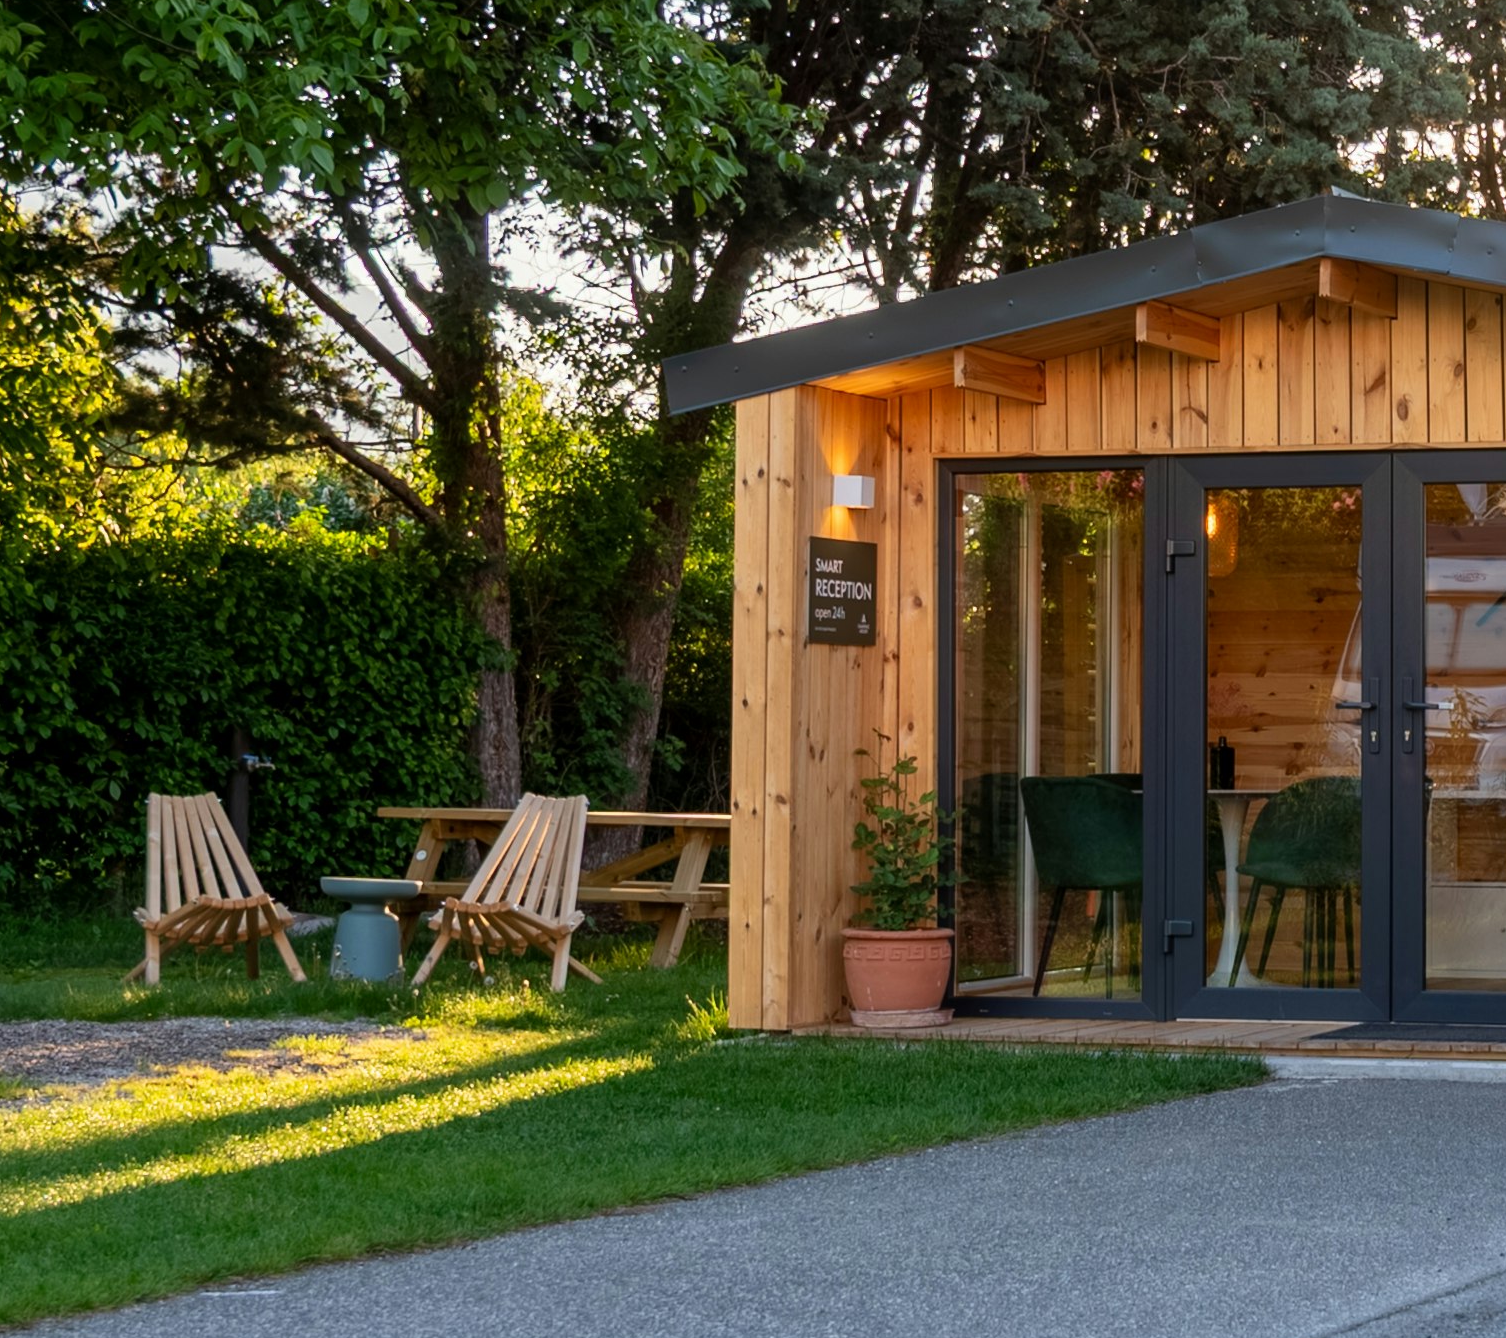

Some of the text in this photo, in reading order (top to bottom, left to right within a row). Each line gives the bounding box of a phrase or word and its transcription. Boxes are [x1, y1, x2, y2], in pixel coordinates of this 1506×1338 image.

[815, 558, 843, 574] SMART
[815, 578, 872, 600] RECEPTION
[814, 606, 846, 621] open 24h
